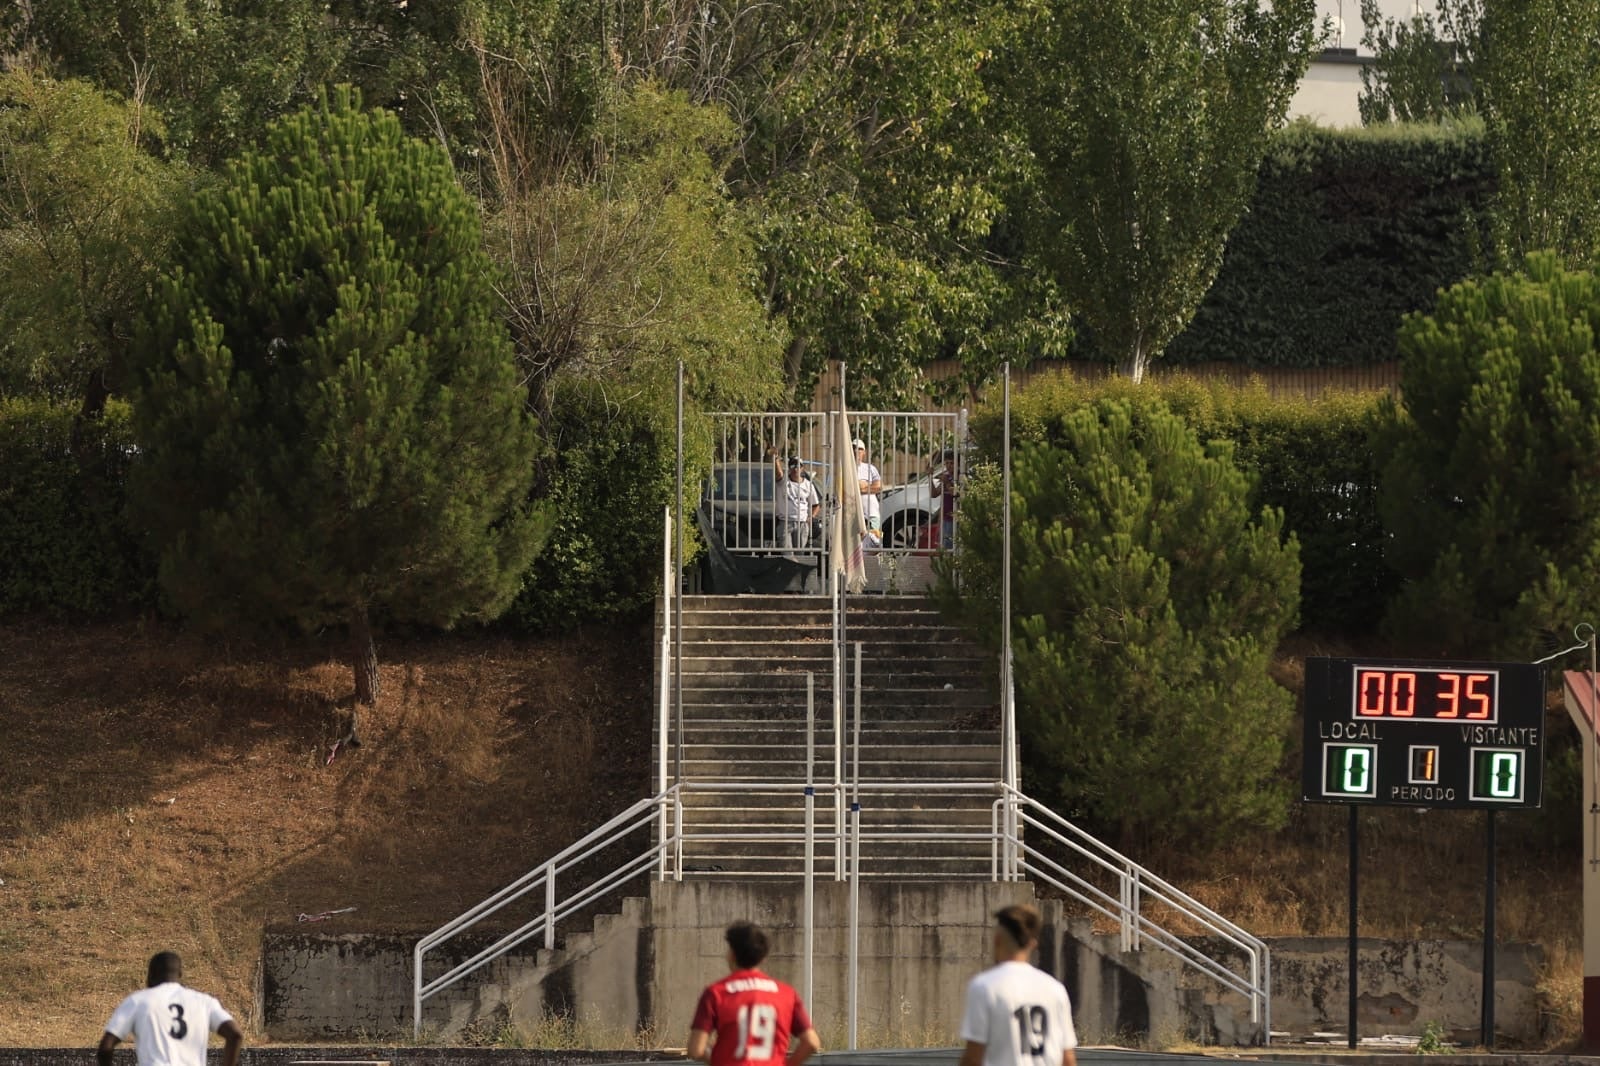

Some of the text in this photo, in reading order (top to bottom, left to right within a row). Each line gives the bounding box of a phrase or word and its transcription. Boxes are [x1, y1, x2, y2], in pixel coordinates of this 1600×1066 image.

[1360, 672, 1490, 719] 00 35
[1319, 722, 1383, 740] LOCAL
[1460, 726, 1538, 746] VISITANTE
[1344, 748, 1370, 792] 0
[1491, 753, 1518, 798] 0
[1391, 786, 1456, 801] PERIODO
[168, 1003, 188, 1040] 3
[734, 1003, 777, 1061] 19
[1014, 1005, 1048, 1056] 19
